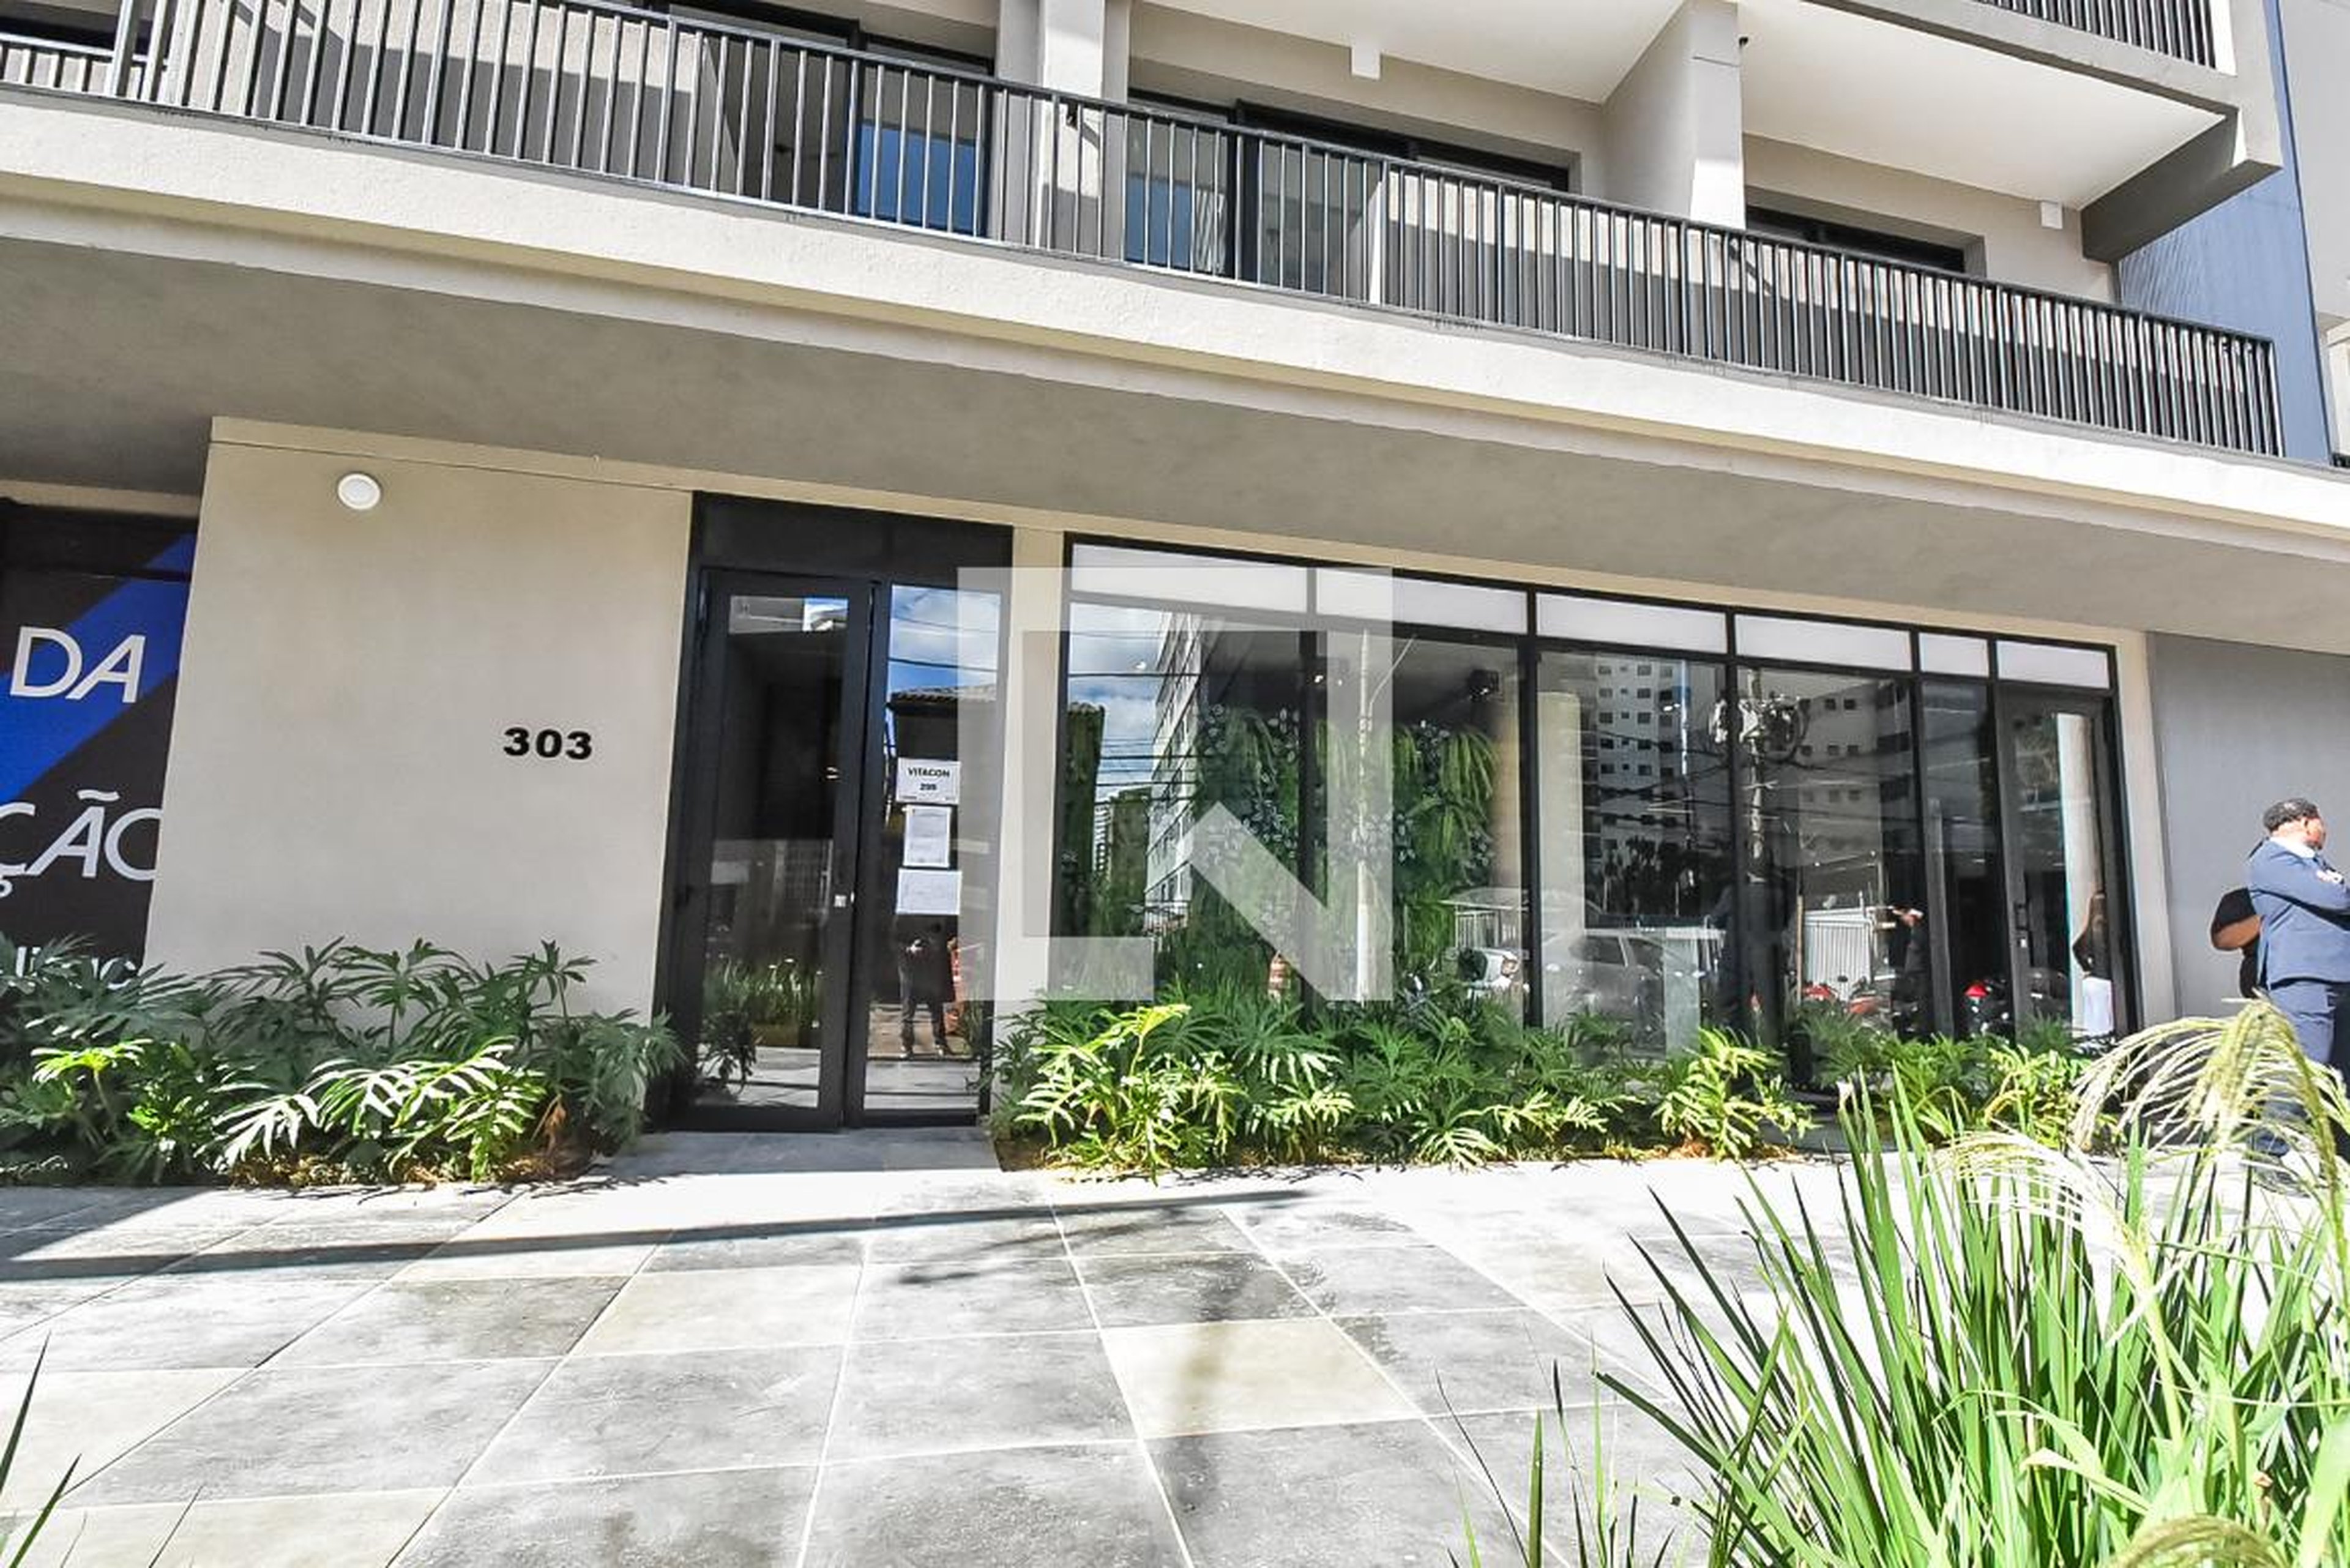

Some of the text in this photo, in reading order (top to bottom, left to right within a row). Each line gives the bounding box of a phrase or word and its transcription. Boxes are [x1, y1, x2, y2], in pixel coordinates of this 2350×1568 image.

[10, 626, 146, 703] DA
[503, 727, 592, 760] 303
[908, 767, 950, 777] VITACON
